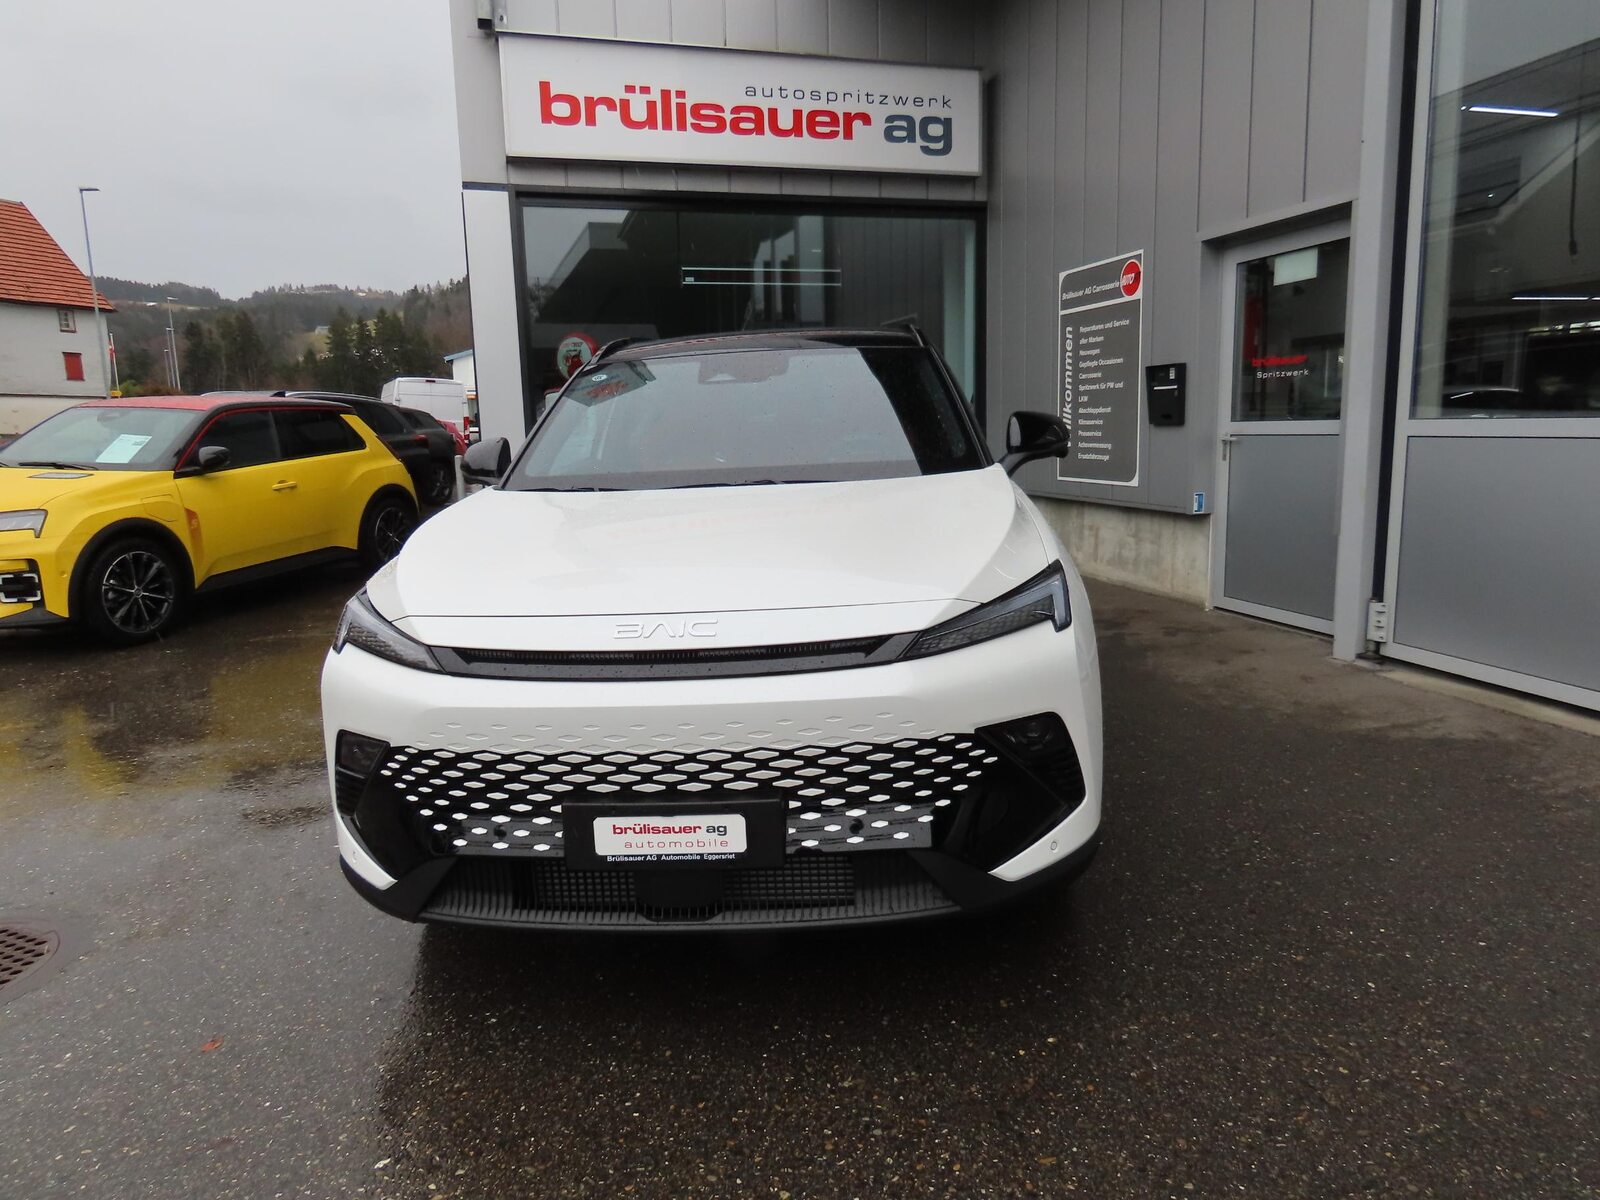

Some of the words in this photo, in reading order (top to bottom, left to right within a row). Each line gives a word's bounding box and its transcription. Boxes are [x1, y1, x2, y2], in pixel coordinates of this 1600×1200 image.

[745, 84, 952, 110] autospritzwerk
[539, 80, 872, 140] brülisauer
[883, 113, 953, 157] ag
[1084, 286, 1092, 295] AG
[1105, 321, 1113, 329] und
[1113, 319, 1130, 327] Service
[1256, 368, 1309, 379] Spritzwerk
[1062, 326, 1073, 447] illkommen
[613, 617, 719, 639] BAIC
[612, 823, 702, 835] brülisauer
[706, 825, 728, 836] ag
[624, 838, 729, 849] automobile
[661, 853, 701, 861] Automobile
